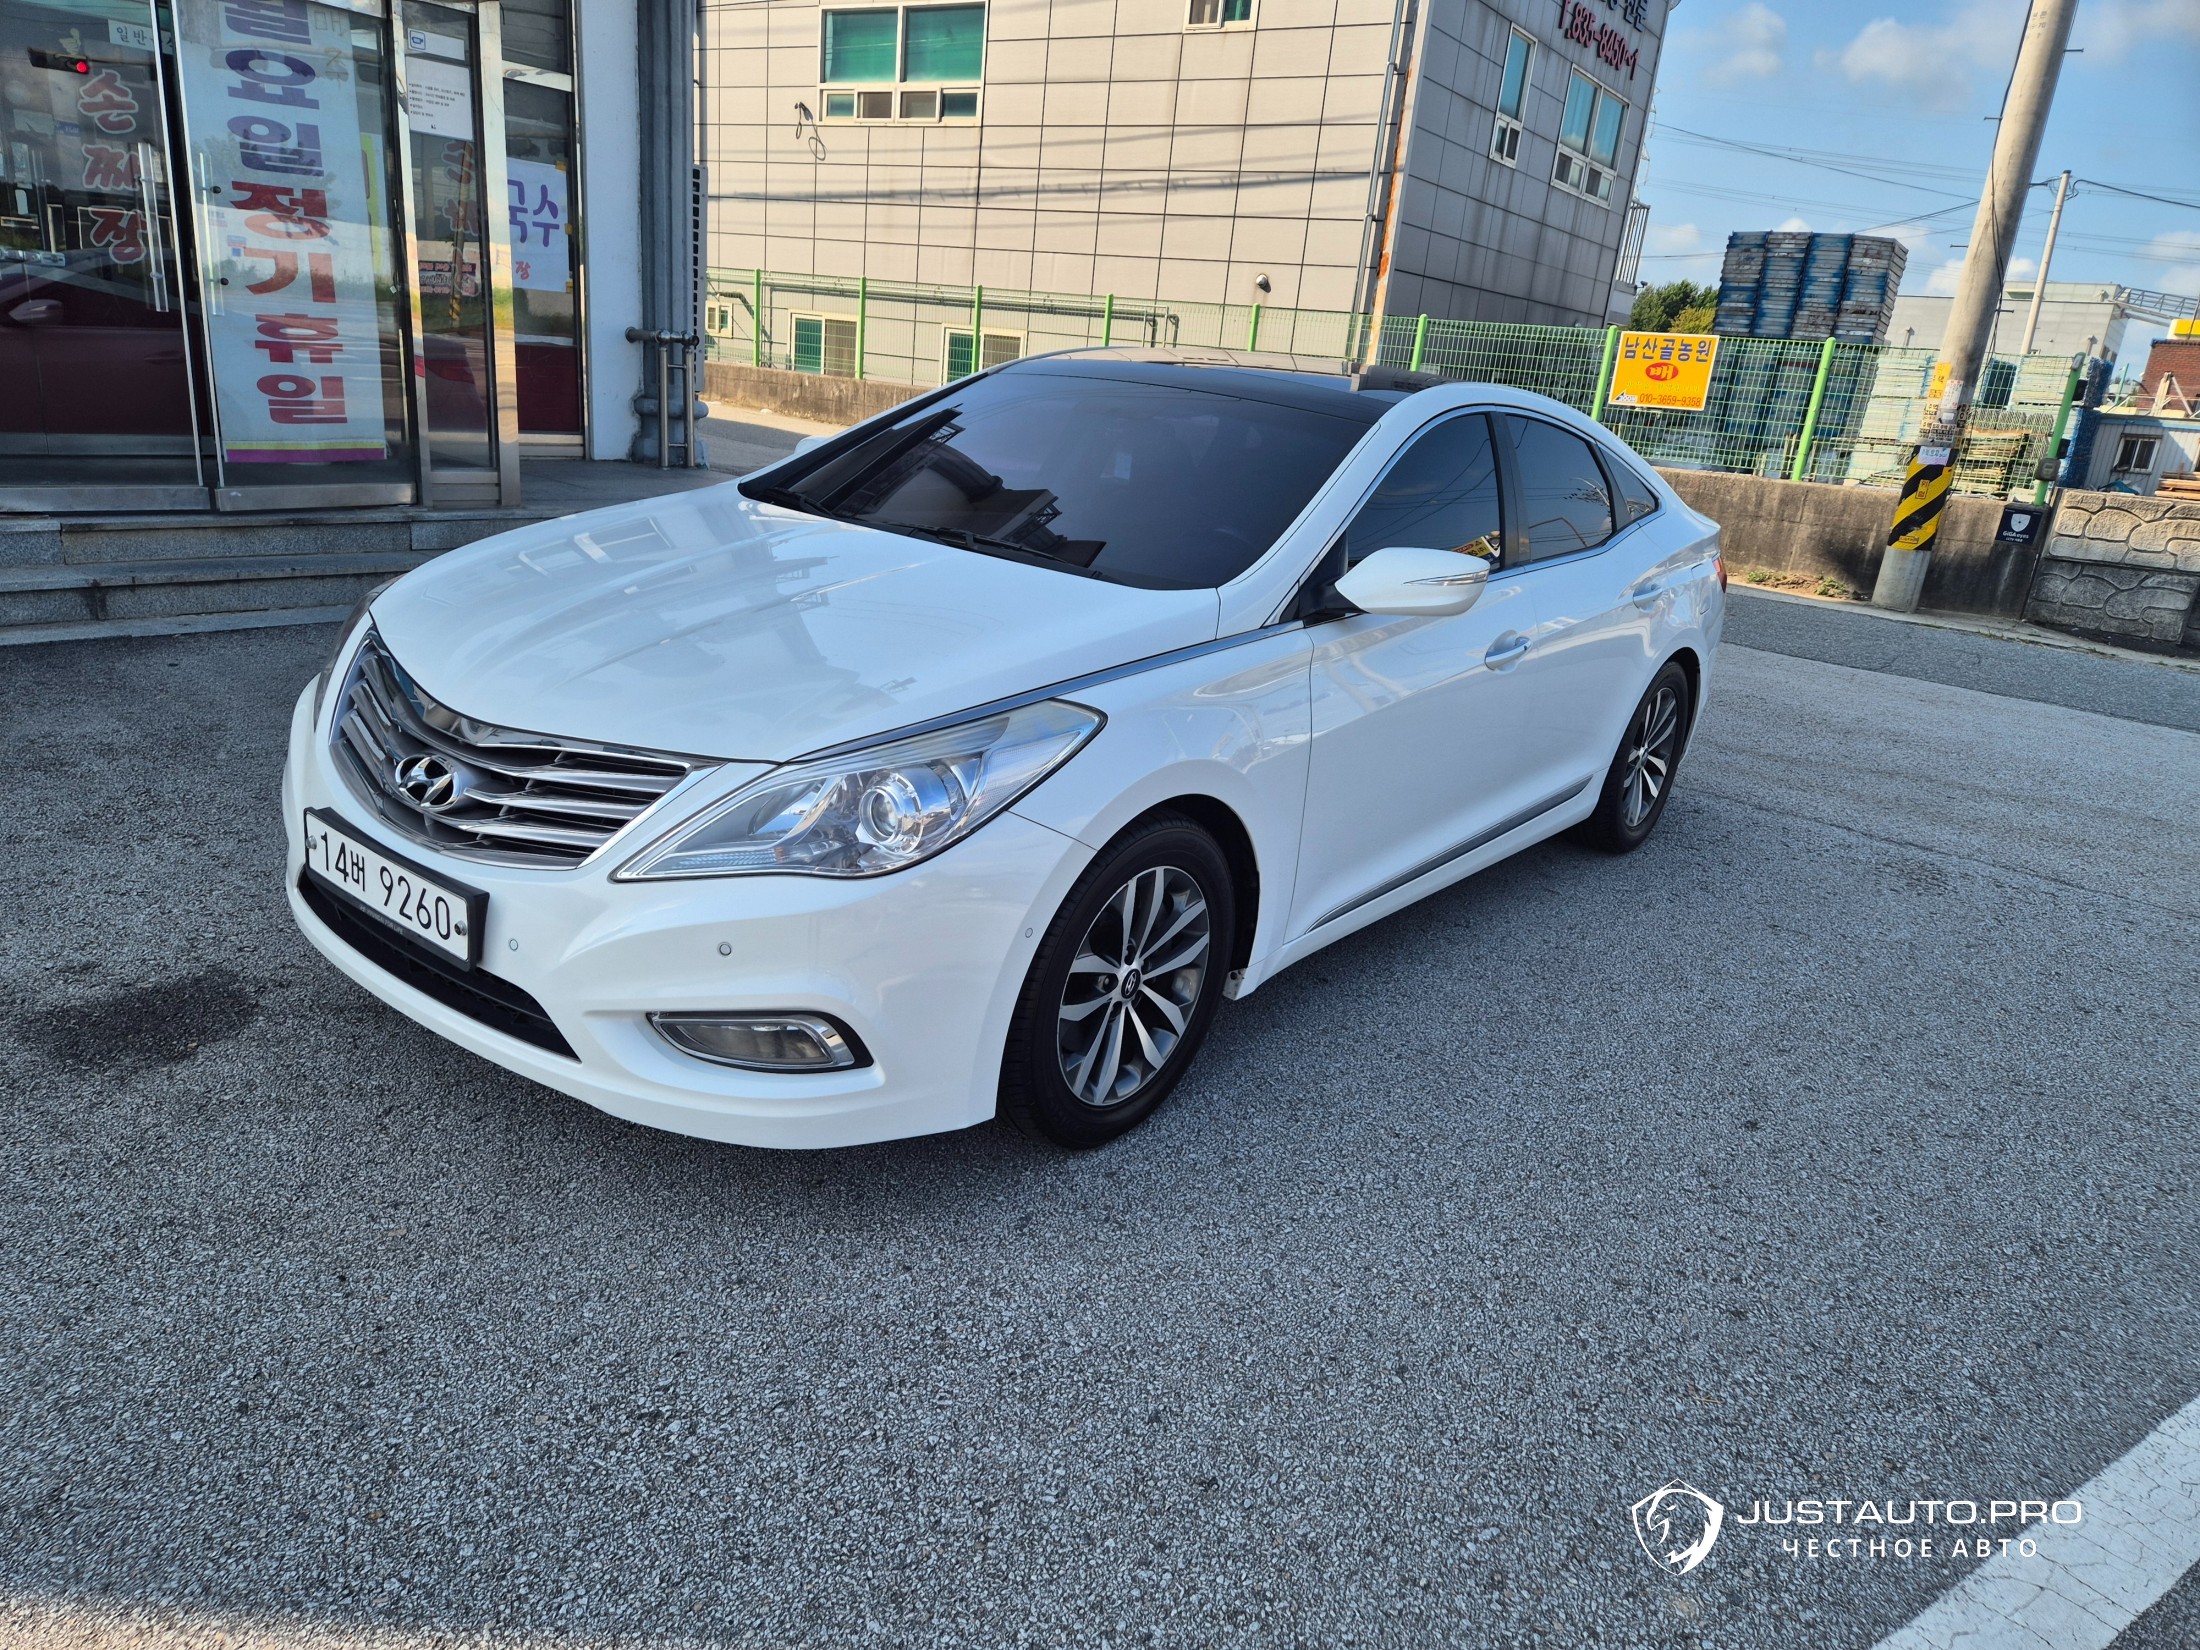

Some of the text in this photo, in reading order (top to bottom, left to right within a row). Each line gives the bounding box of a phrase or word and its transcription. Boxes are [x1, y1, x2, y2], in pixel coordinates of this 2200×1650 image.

[231, 180, 348, 425] 정기휴일
[1624, 337, 1712, 363] 남산골농원
[320, 831, 451, 941] 14버 9260
